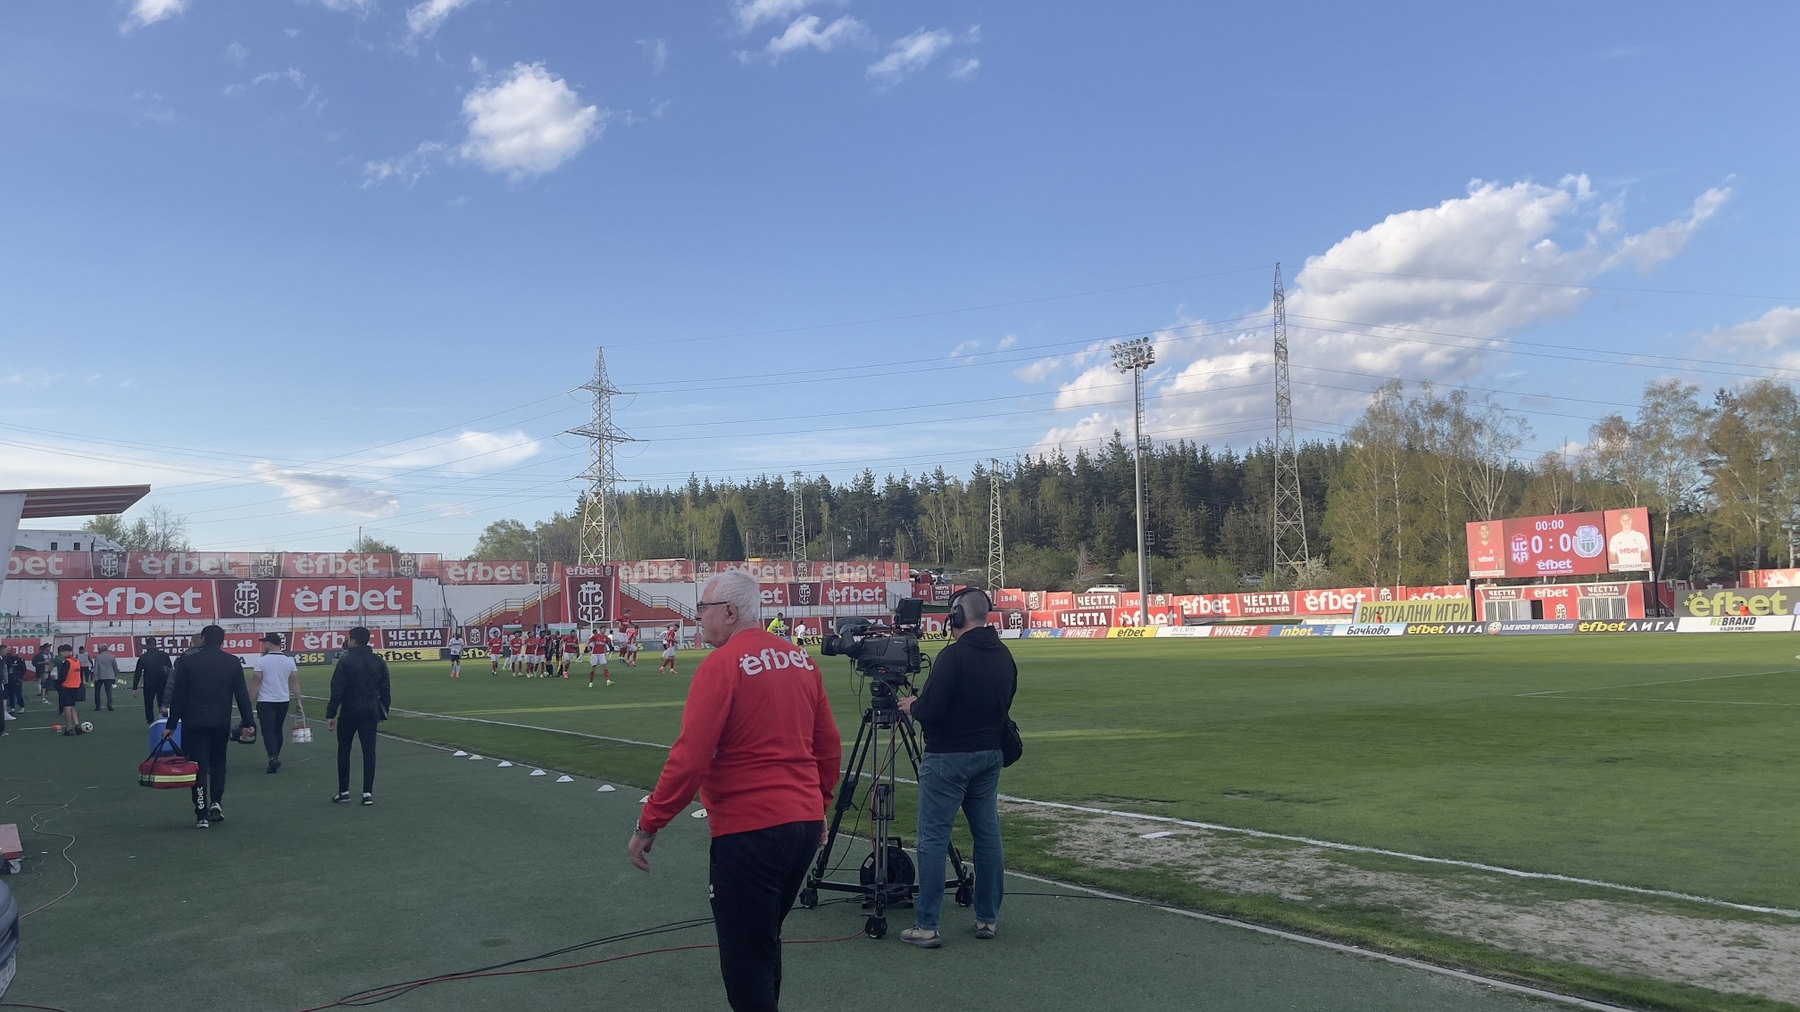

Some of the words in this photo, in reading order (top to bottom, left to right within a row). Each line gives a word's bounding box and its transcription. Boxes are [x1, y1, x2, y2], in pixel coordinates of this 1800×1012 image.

[1536, 519, 1564, 531] 00:00
[141, 553, 235, 575] efbet
[295, 554, 379, 575] efbet
[1537, 559, 1573, 570] efbet
[448, 562, 522, 581] efbet
[566, 567, 600, 575] efbet
[619, 562, 683, 580] efbet
[822, 562, 876, 579] efbet
[294, 585, 402, 612] efbet
[828, 586, 883, 602] efbet
[1534, 588, 1569, 598] efbet
[76, 586, 202, 615] efbet
[1077, 594, 1116, 606] ЧЕСТТА
[1126, 599, 1140, 607] 194
[1182, 595, 1231, 615] efbet
[1243, 593, 1290, 607] ЧЕСТТА
[1305, 590, 1366, 611] efbet
[1689, 590, 1788, 617] efbet
[1061, 612, 1107, 626] ЧЕСТТА
[1360, 604, 1432, 624] ВИРТУАЛНИ
[1435, 603, 1469, 621] ИГРИ
[1032, 620, 1052, 628] 1948
[1579, 621, 1627, 632] efbet
[1626, 621, 1675, 631] ЛИГА
[1709, 616, 1757, 627] REBRAND
[389, 629, 442, 641] ЧЕСТТА
[1029, 630, 1051, 638] inbet
[1066, 628, 1099, 638] WINBET
[1117, 628, 1146, 637] efbet
[1213, 626, 1257, 636] WINBET
[1280, 626, 1314, 636] inbet
[1346, 625, 1390, 635] Бачково
[1408, 624, 1446, 634] efbet
[1445, 624, 1483, 633] ЛИГА
[141, 636, 193, 648] ЕСТТ
[304, 632, 375, 649] efb
[920, 631, 947, 641] fbet
[93, 643, 124, 652] 148
[222, 640, 253, 648] 1948
[289, 653, 325, 664] t365
[742, 648, 814, 676] efbet
[197, 786, 205, 810] efbet
